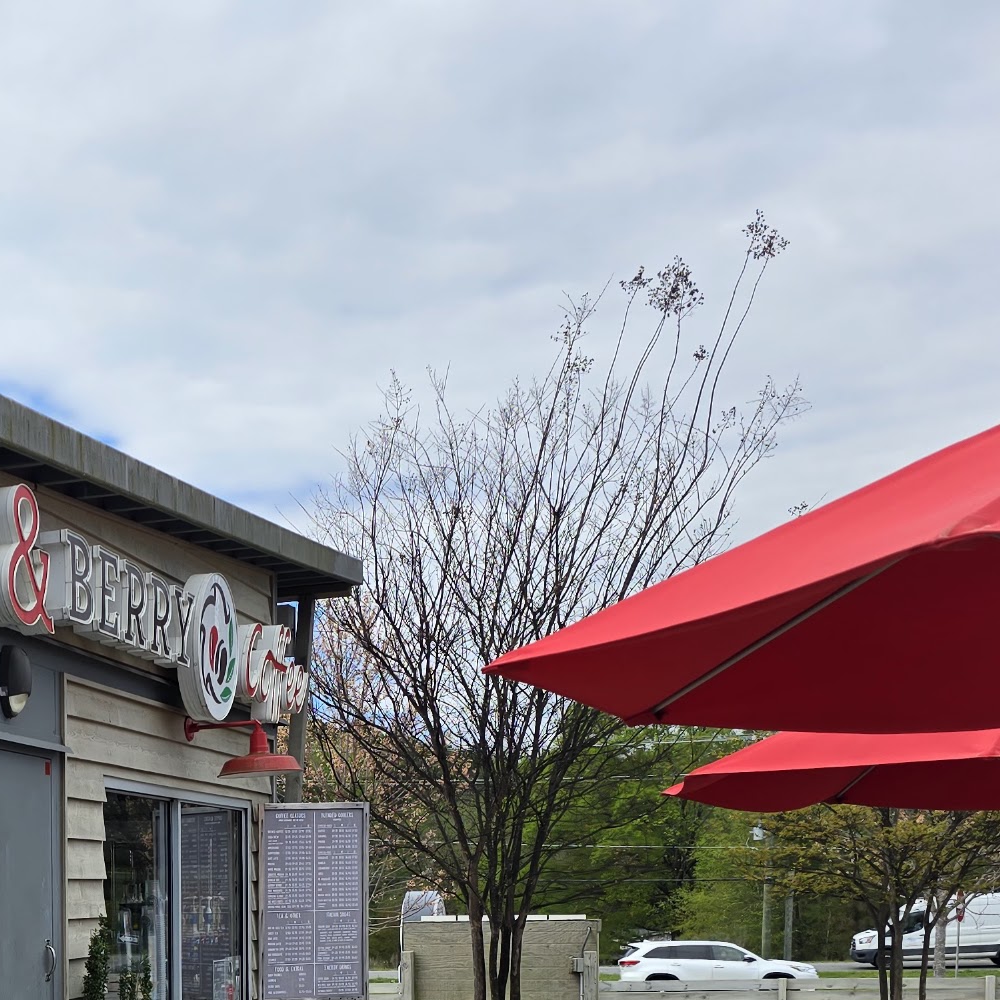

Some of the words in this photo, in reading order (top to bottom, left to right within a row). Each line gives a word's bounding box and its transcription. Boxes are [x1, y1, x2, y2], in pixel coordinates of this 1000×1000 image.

[8, 484, 55, 634] &
[66, 529, 196, 668] BERRY
[245, 623, 308, 724] Coffee
